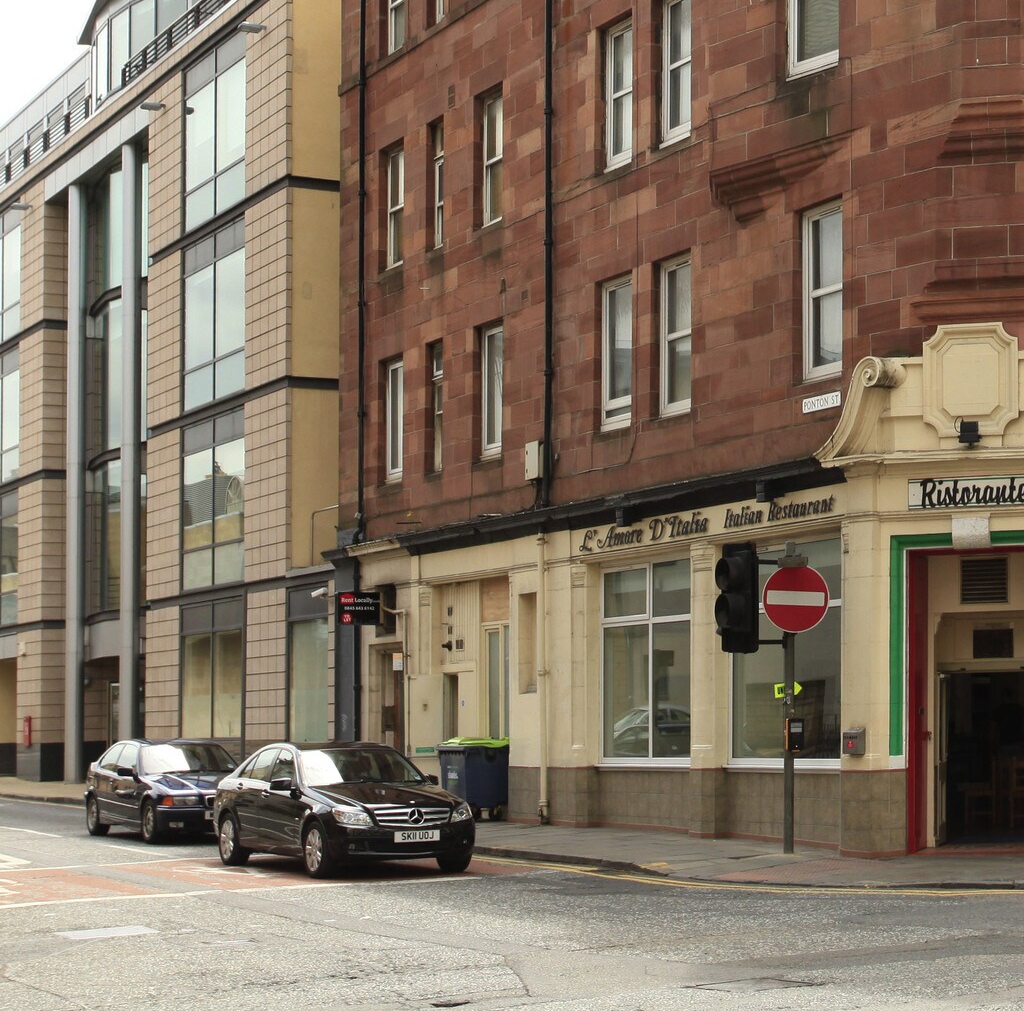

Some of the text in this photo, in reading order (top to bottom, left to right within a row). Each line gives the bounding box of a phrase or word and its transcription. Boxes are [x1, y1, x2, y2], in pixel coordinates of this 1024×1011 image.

[804, 395, 839, 410] PONTON ST
[649, 511, 709, 541] D'Italia
[723, 505, 763, 529] Italian
[767, 494, 835, 522] Restaurant
